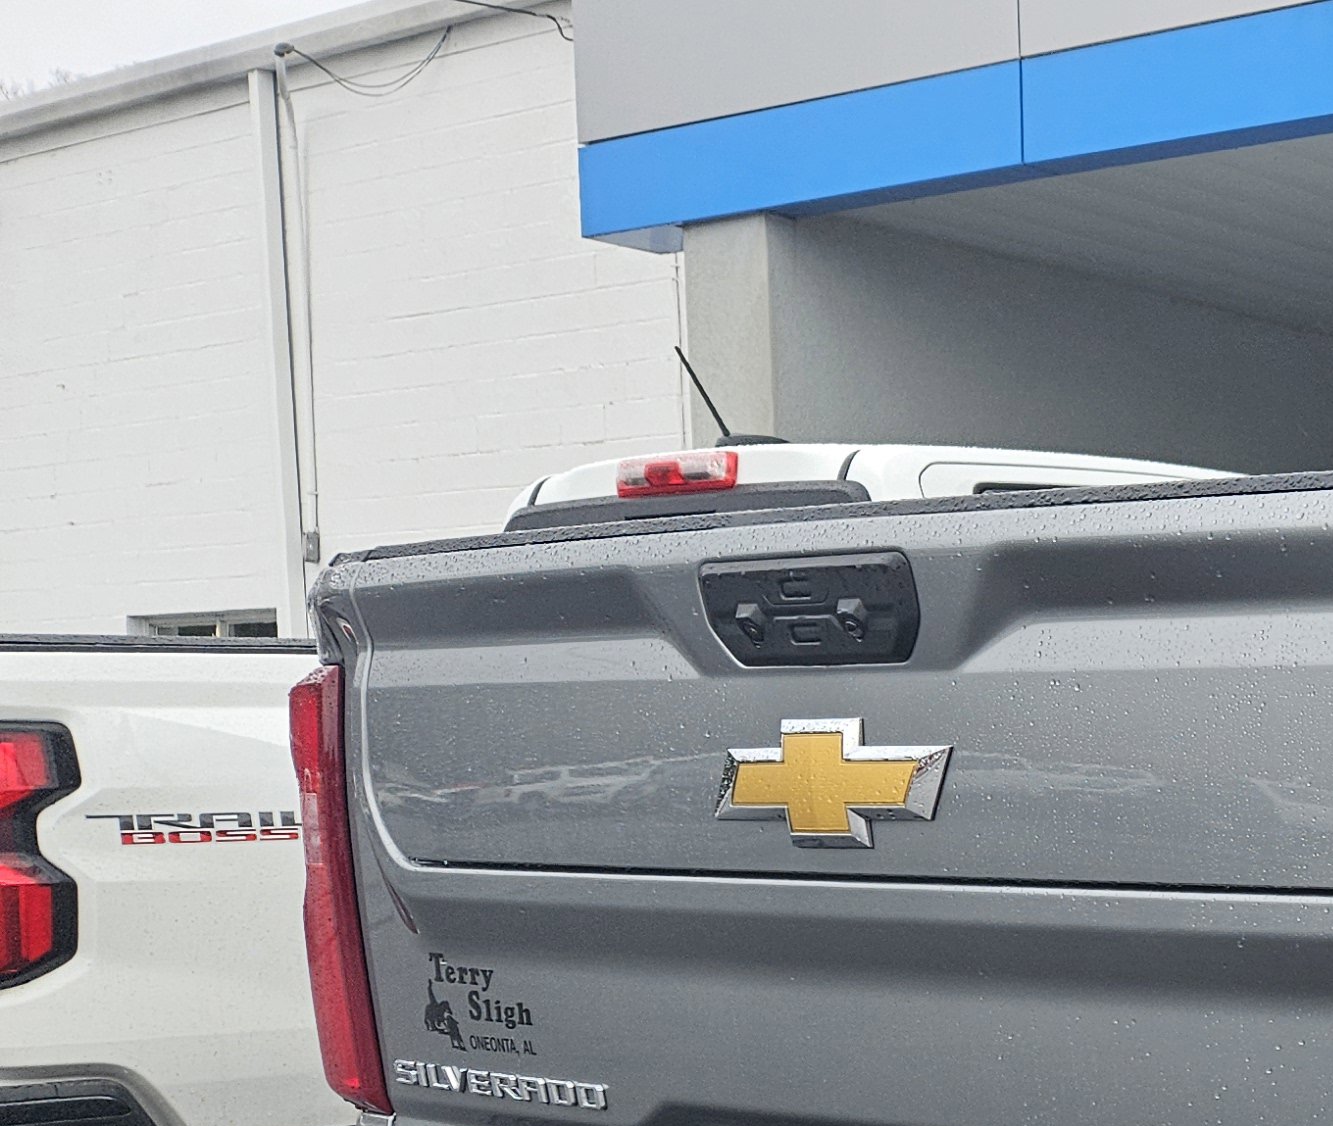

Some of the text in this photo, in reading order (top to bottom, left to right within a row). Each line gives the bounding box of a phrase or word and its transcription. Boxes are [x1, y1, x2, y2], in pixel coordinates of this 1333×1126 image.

[85, 811, 302, 830] TRAIL
[121, 828, 299, 845] BOSS
[428, 952, 493, 991] Terry
[468, 991, 533, 1029] Sligh
[470, 1035, 537, 1055] ONEONTA, AL
[394, 1059, 608, 1110] SILVERADO
